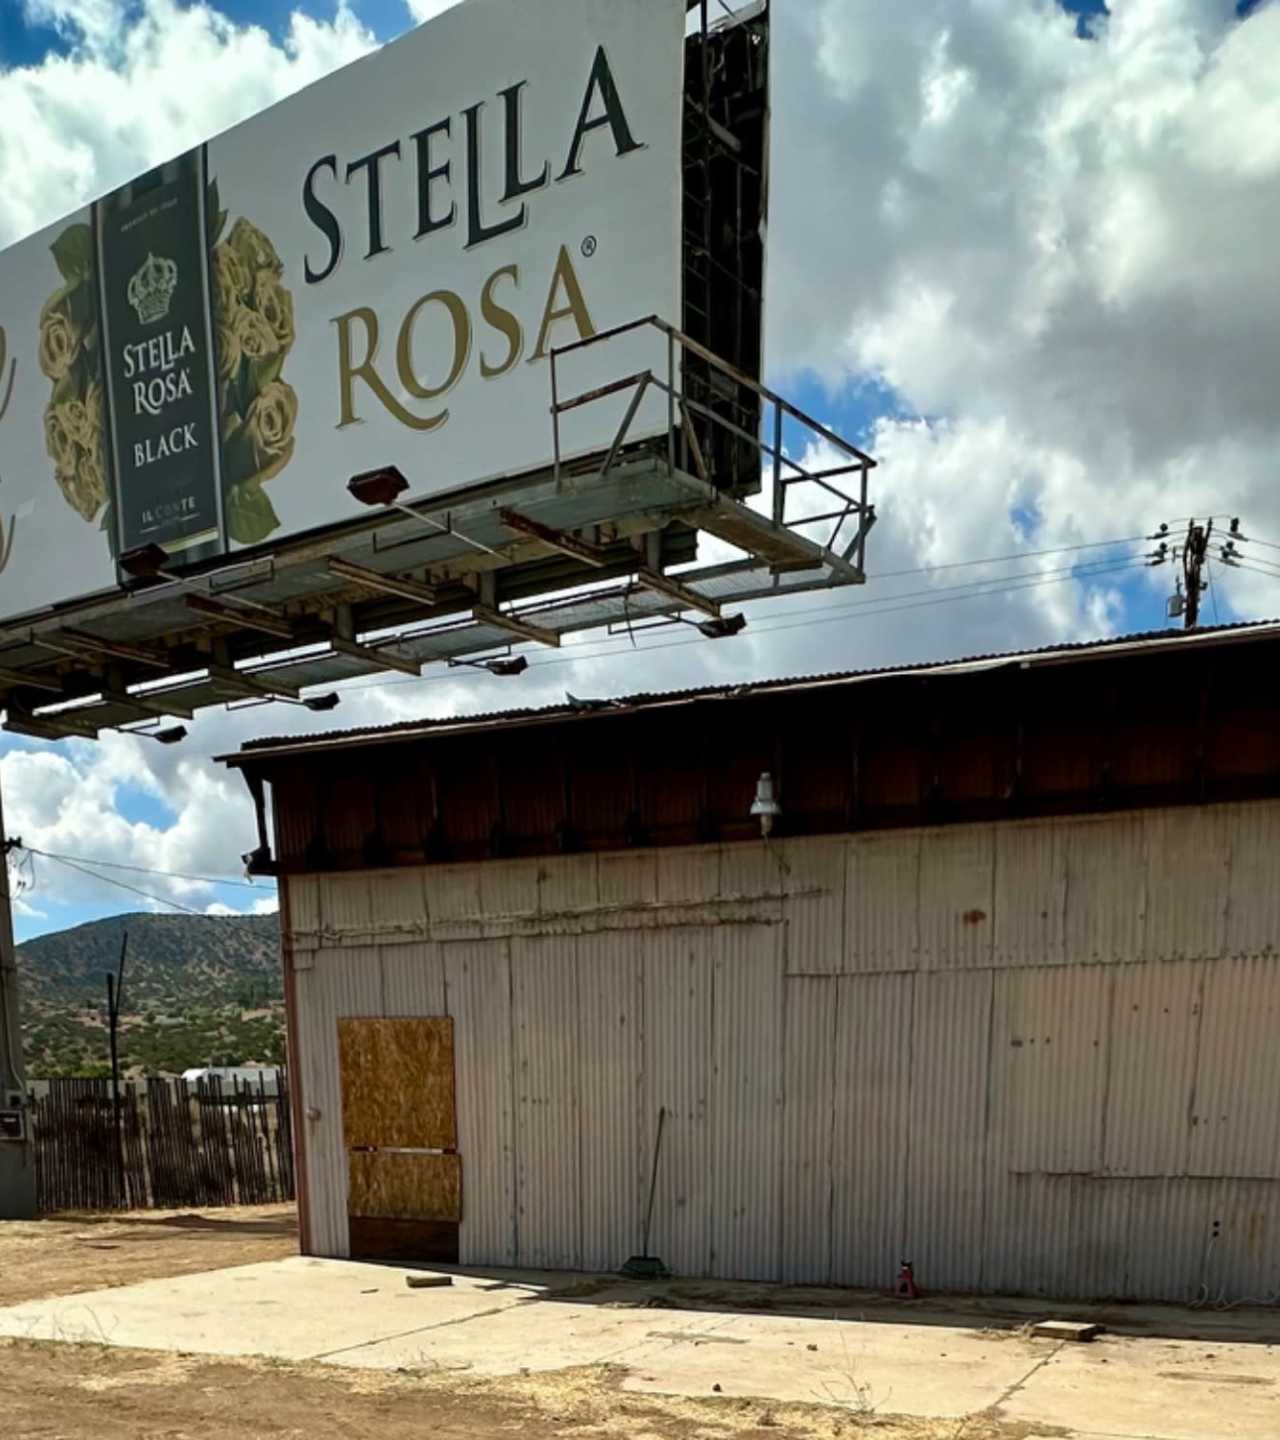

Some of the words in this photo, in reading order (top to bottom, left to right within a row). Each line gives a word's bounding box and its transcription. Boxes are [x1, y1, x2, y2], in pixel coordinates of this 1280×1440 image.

[303, 45, 648, 285] STELLA
[123, 325, 196, 378] STELLA
[133, 368, 192, 415] ROSA
[134, 422, 198, 468] BLACK
